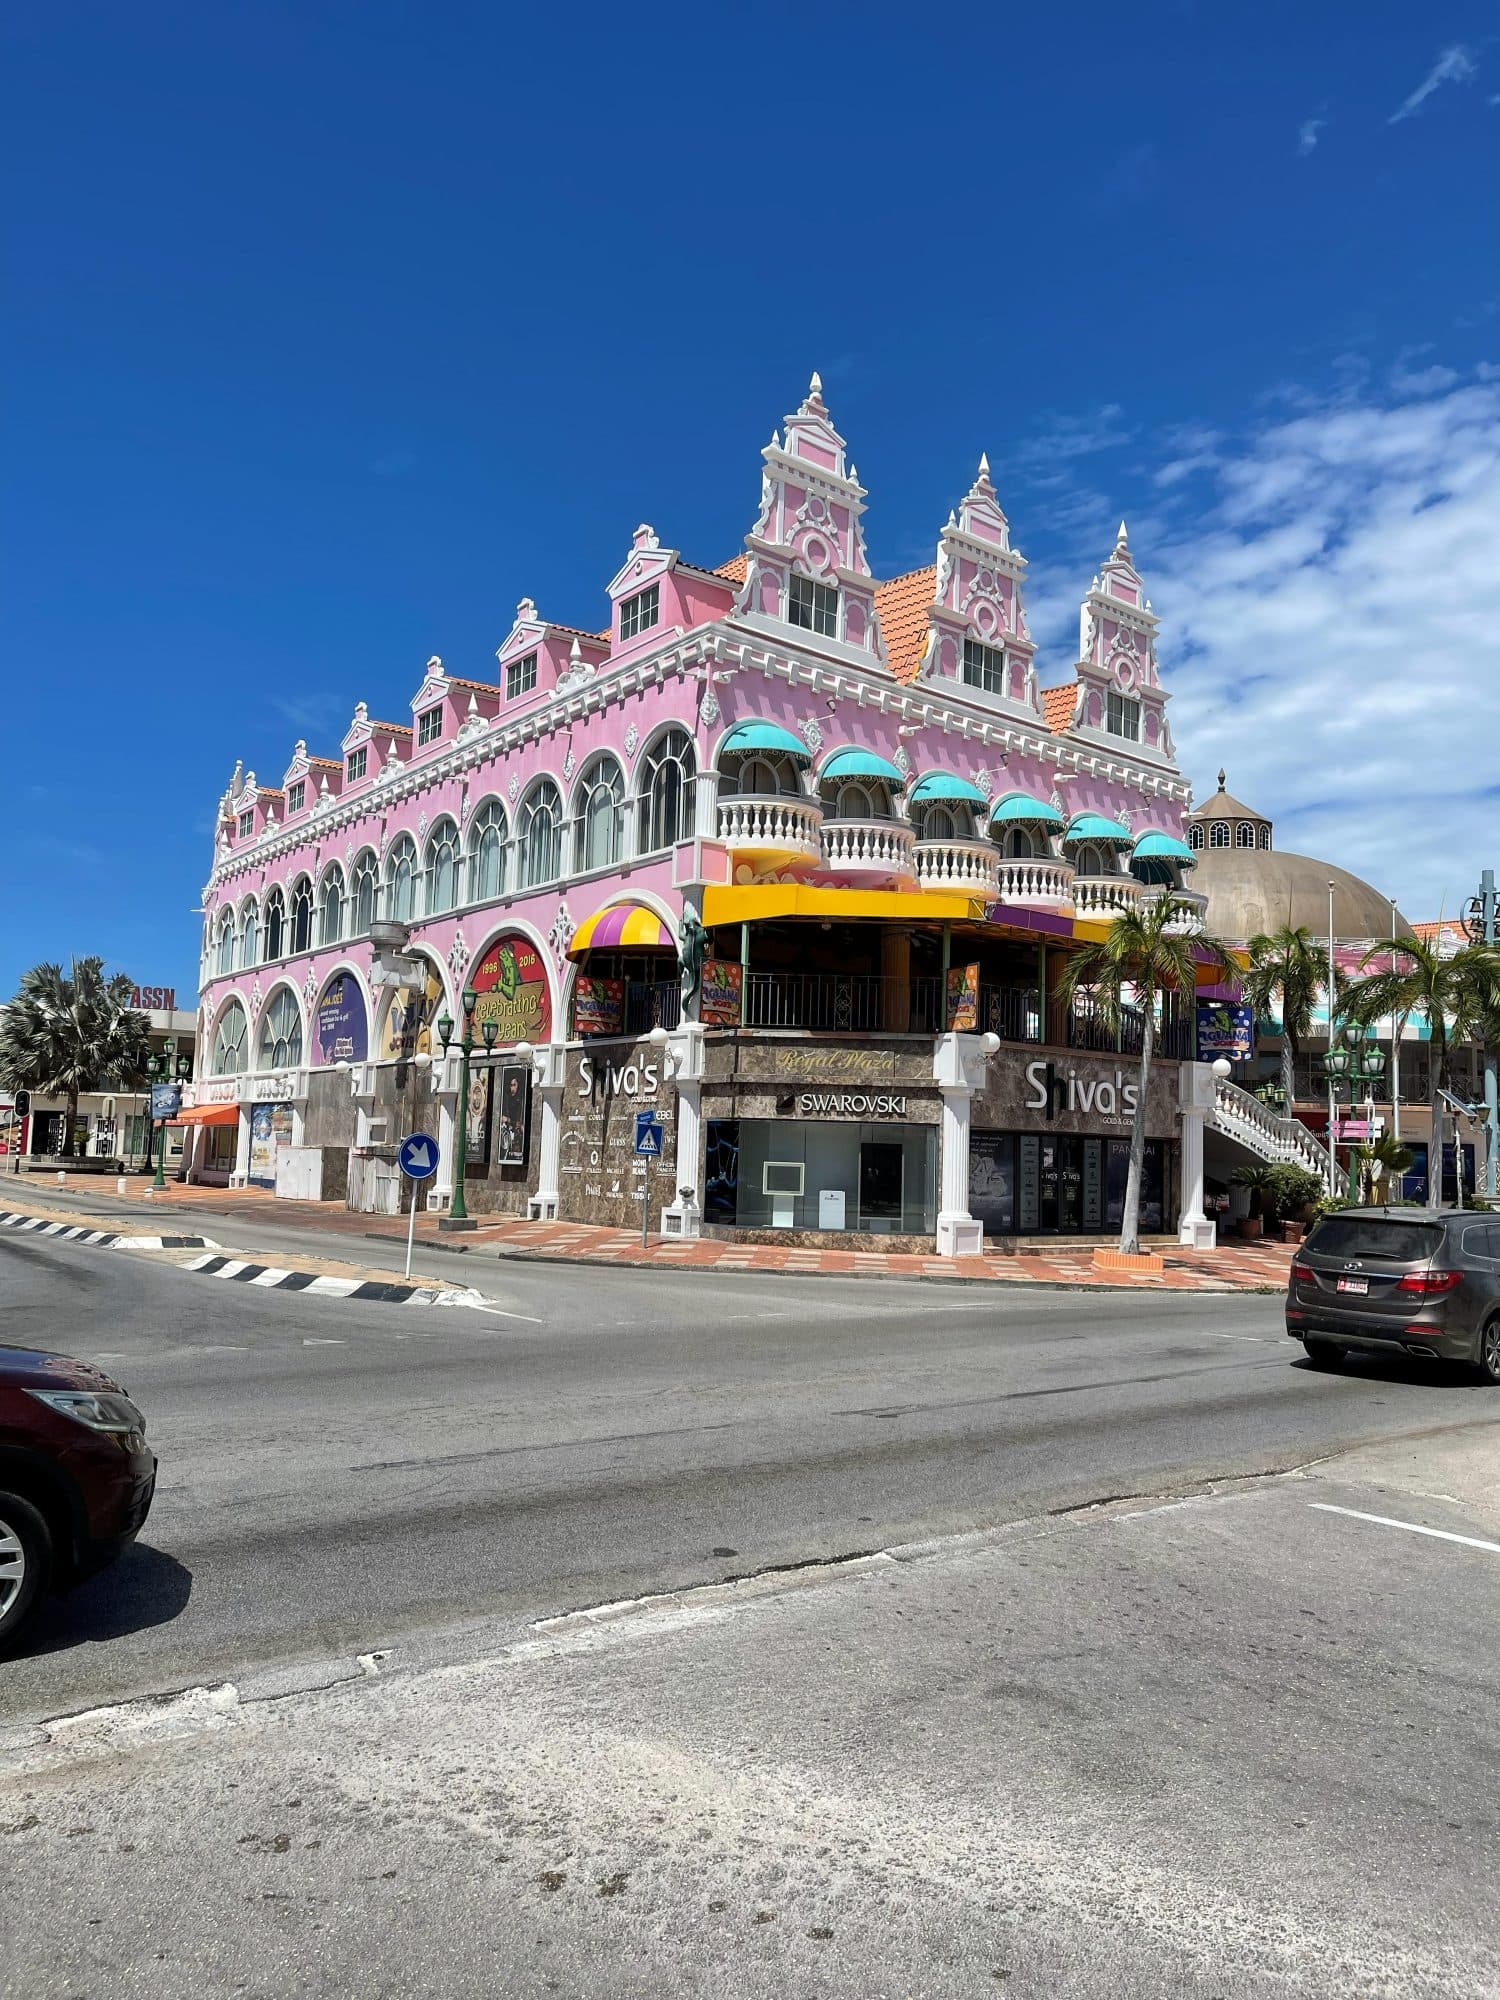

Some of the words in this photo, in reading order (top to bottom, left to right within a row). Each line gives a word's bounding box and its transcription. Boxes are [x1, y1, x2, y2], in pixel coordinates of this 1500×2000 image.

[519, 953, 536, 968] 2016
[498, 1020, 527, 1040] years
[778, 1049, 841, 1074] Royal
[839, 1051, 893, 1070] Plaza
[801, 1093, 907, 1113] SWAROVSKI
[1122, 1118, 1135, 1127] GEM
[1112, 1144, 1155, 1156] PANRAI
[631, 1191, 652, 1201] TISST
